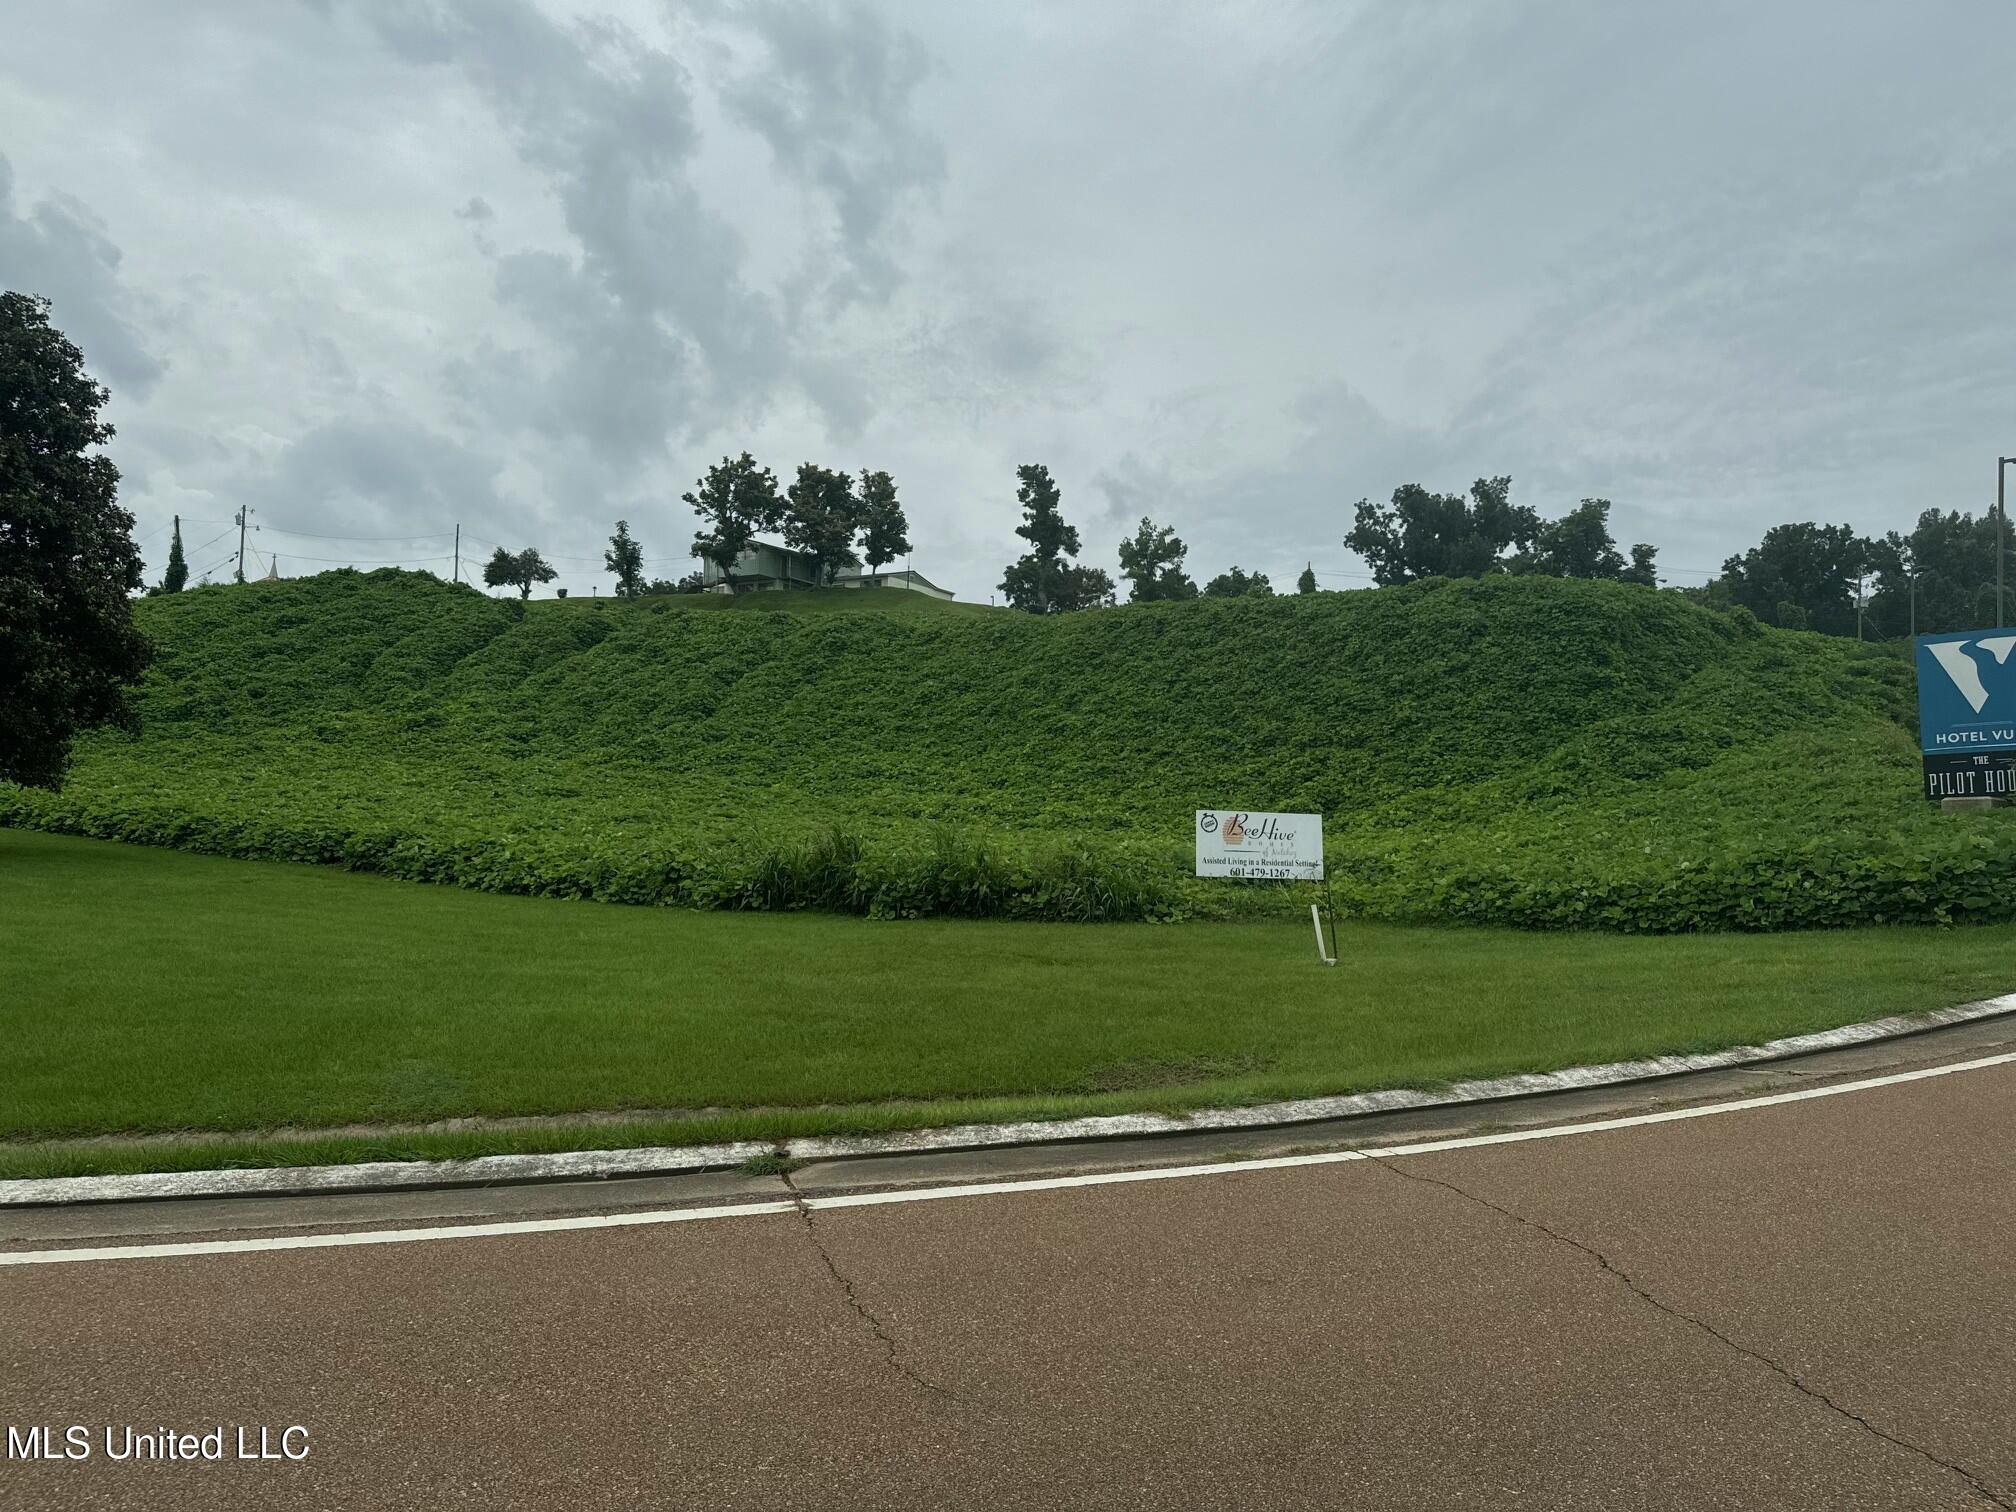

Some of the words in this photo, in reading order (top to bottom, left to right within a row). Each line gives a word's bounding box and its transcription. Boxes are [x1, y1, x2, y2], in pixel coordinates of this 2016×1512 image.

[1936, 732, 1988, 744] HOTEL
[1973, 755, 1989, 765] THE
[1928, 771, 1976, 796] PILOT
[1202, 857, 1227, 865] Assisted
[1228, 858, 1248, 866] Living
[1248, 858, 1255, 866] in
[1261, 859, 1294, 867] Residential
[1229, 867, 1291, 878] 601-479-1267
